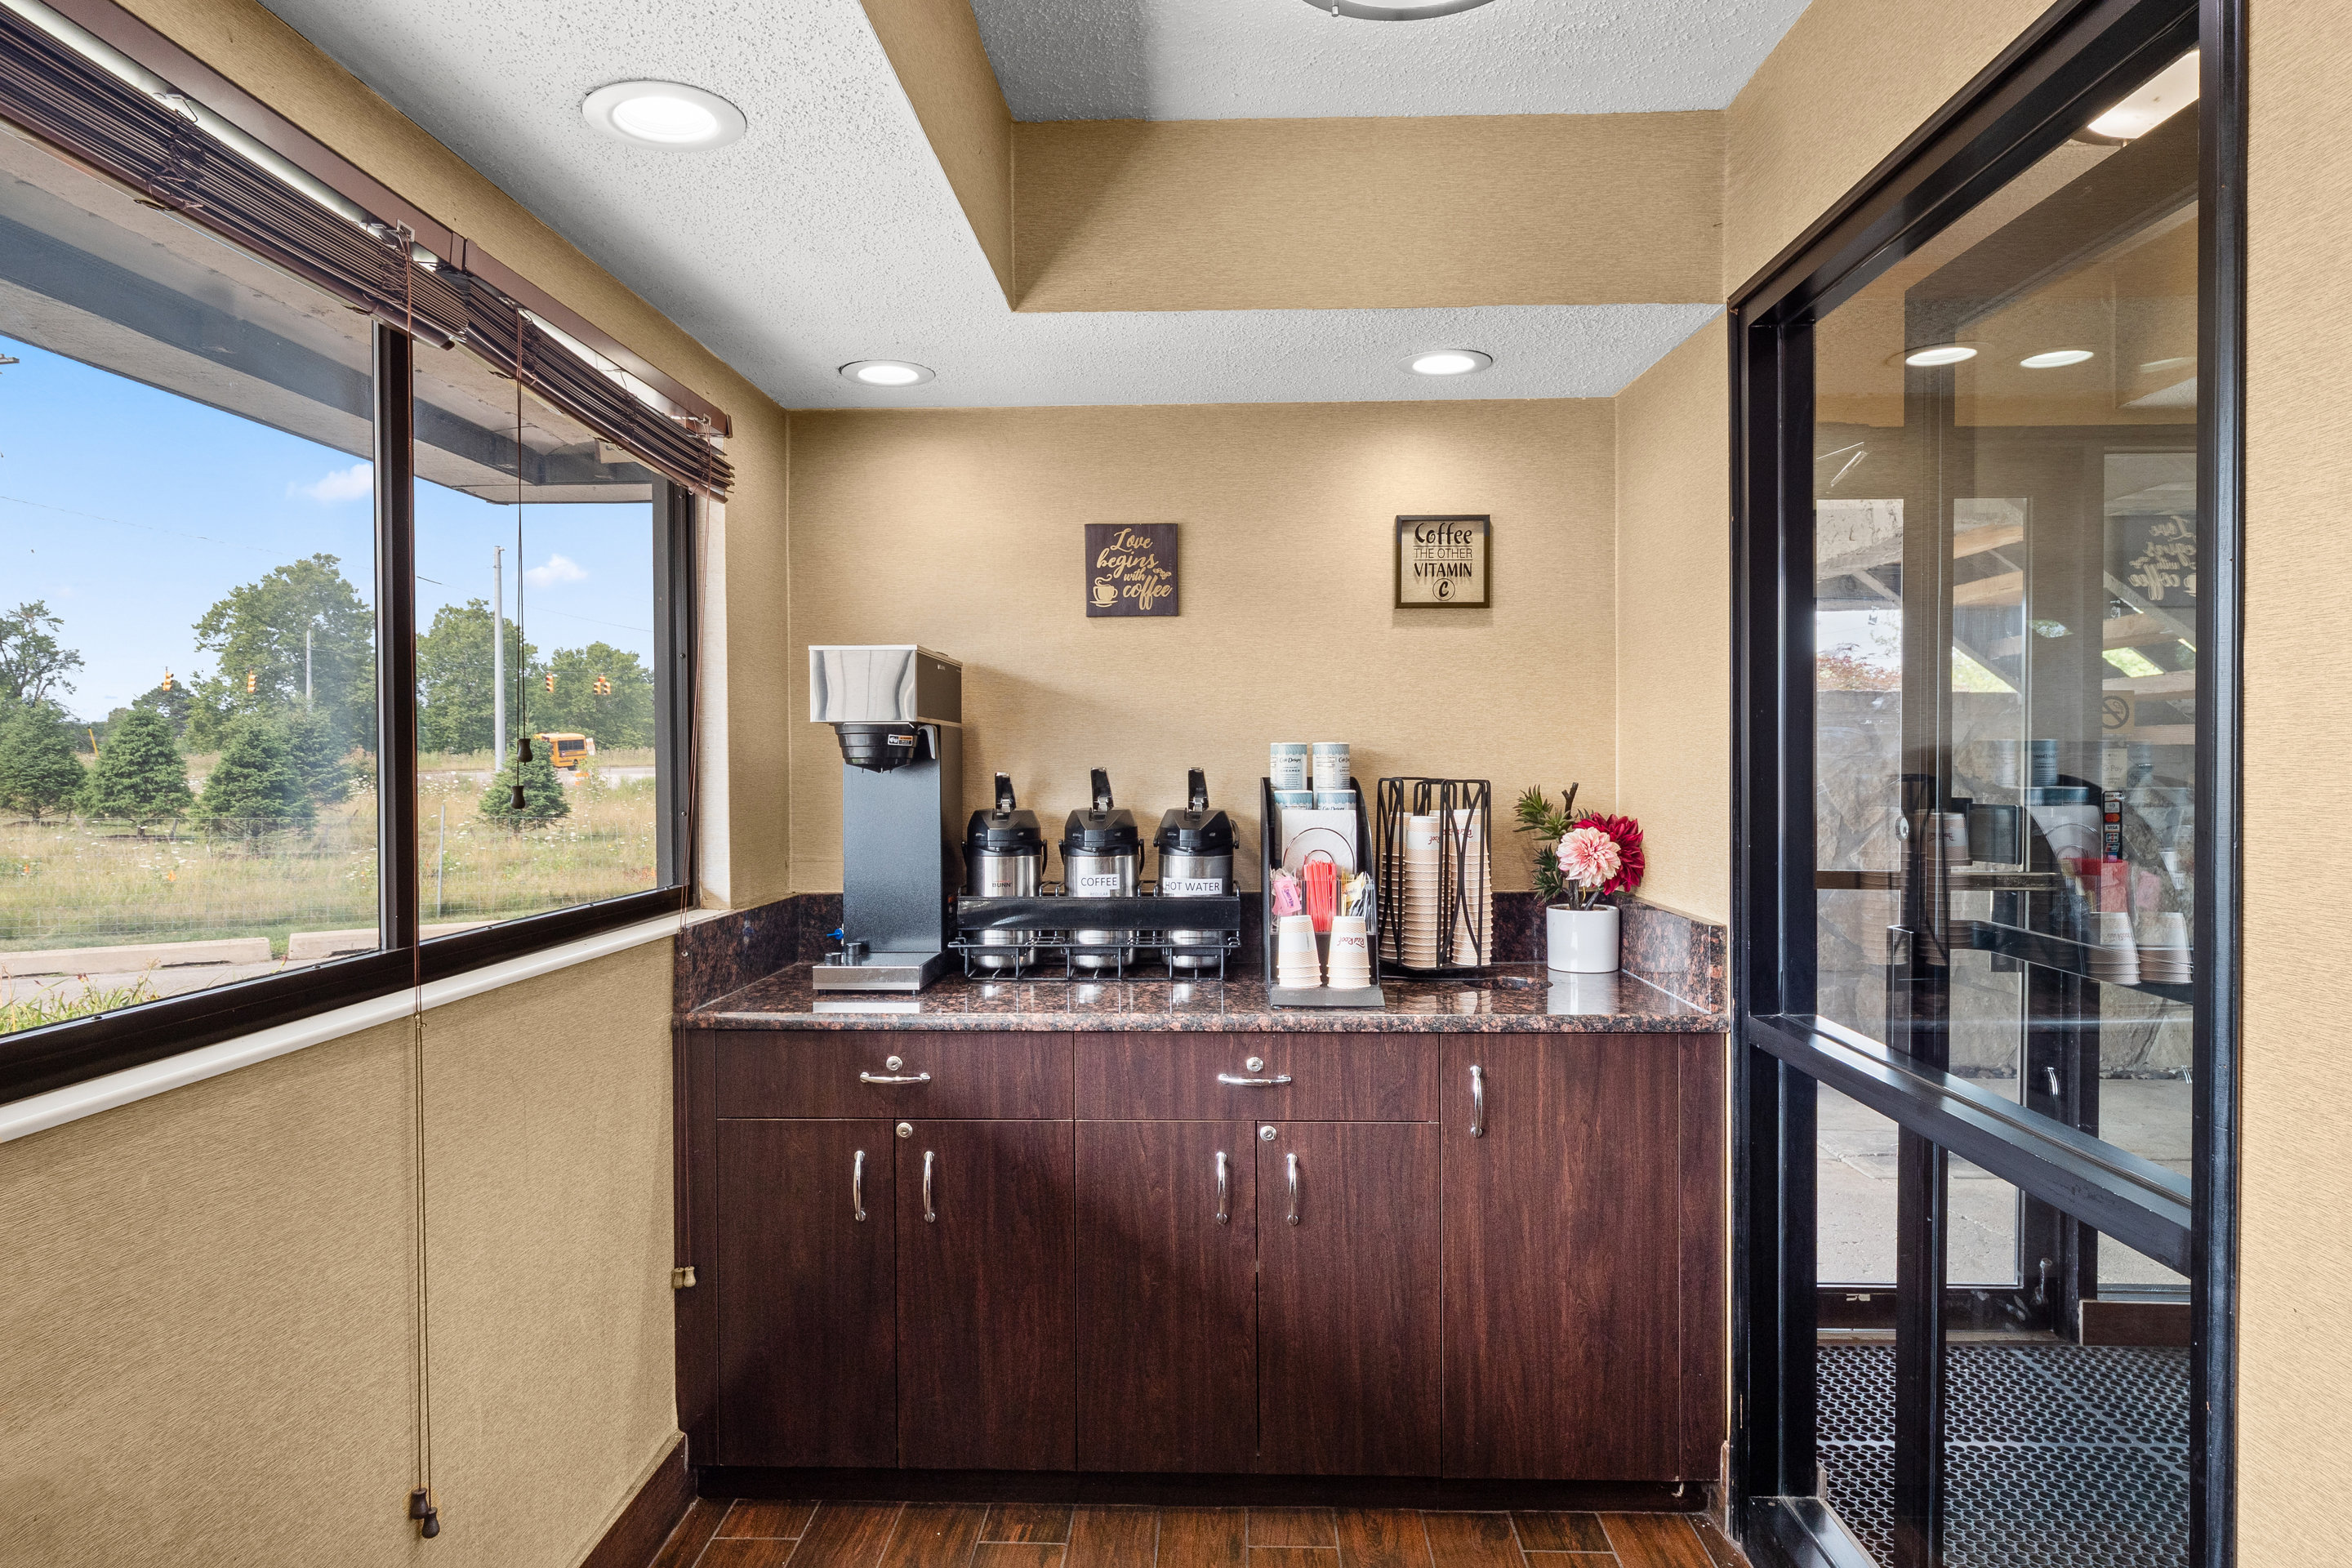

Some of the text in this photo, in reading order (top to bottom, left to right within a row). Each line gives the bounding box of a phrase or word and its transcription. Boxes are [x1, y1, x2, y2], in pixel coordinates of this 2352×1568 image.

[1111, 528, 1153, 553] Love
[1414, 523, 1472, 545] Coffee
[1414, 548, 1472, 559] THE OTHER
[1096, 547, 1160, 579] begins
[1414, 562, 1472, 578] VITAMIN
[1123, 567, 1147, 581] with
[1122, 574, 1173, 611] coffee
[1438, 581, 1450, 598] C
[1080, 877, 1117, 887] COFFEE
[1165, 881, 1220, 892] HOT WATER
[1337, 937, 1353, 947] Roof
